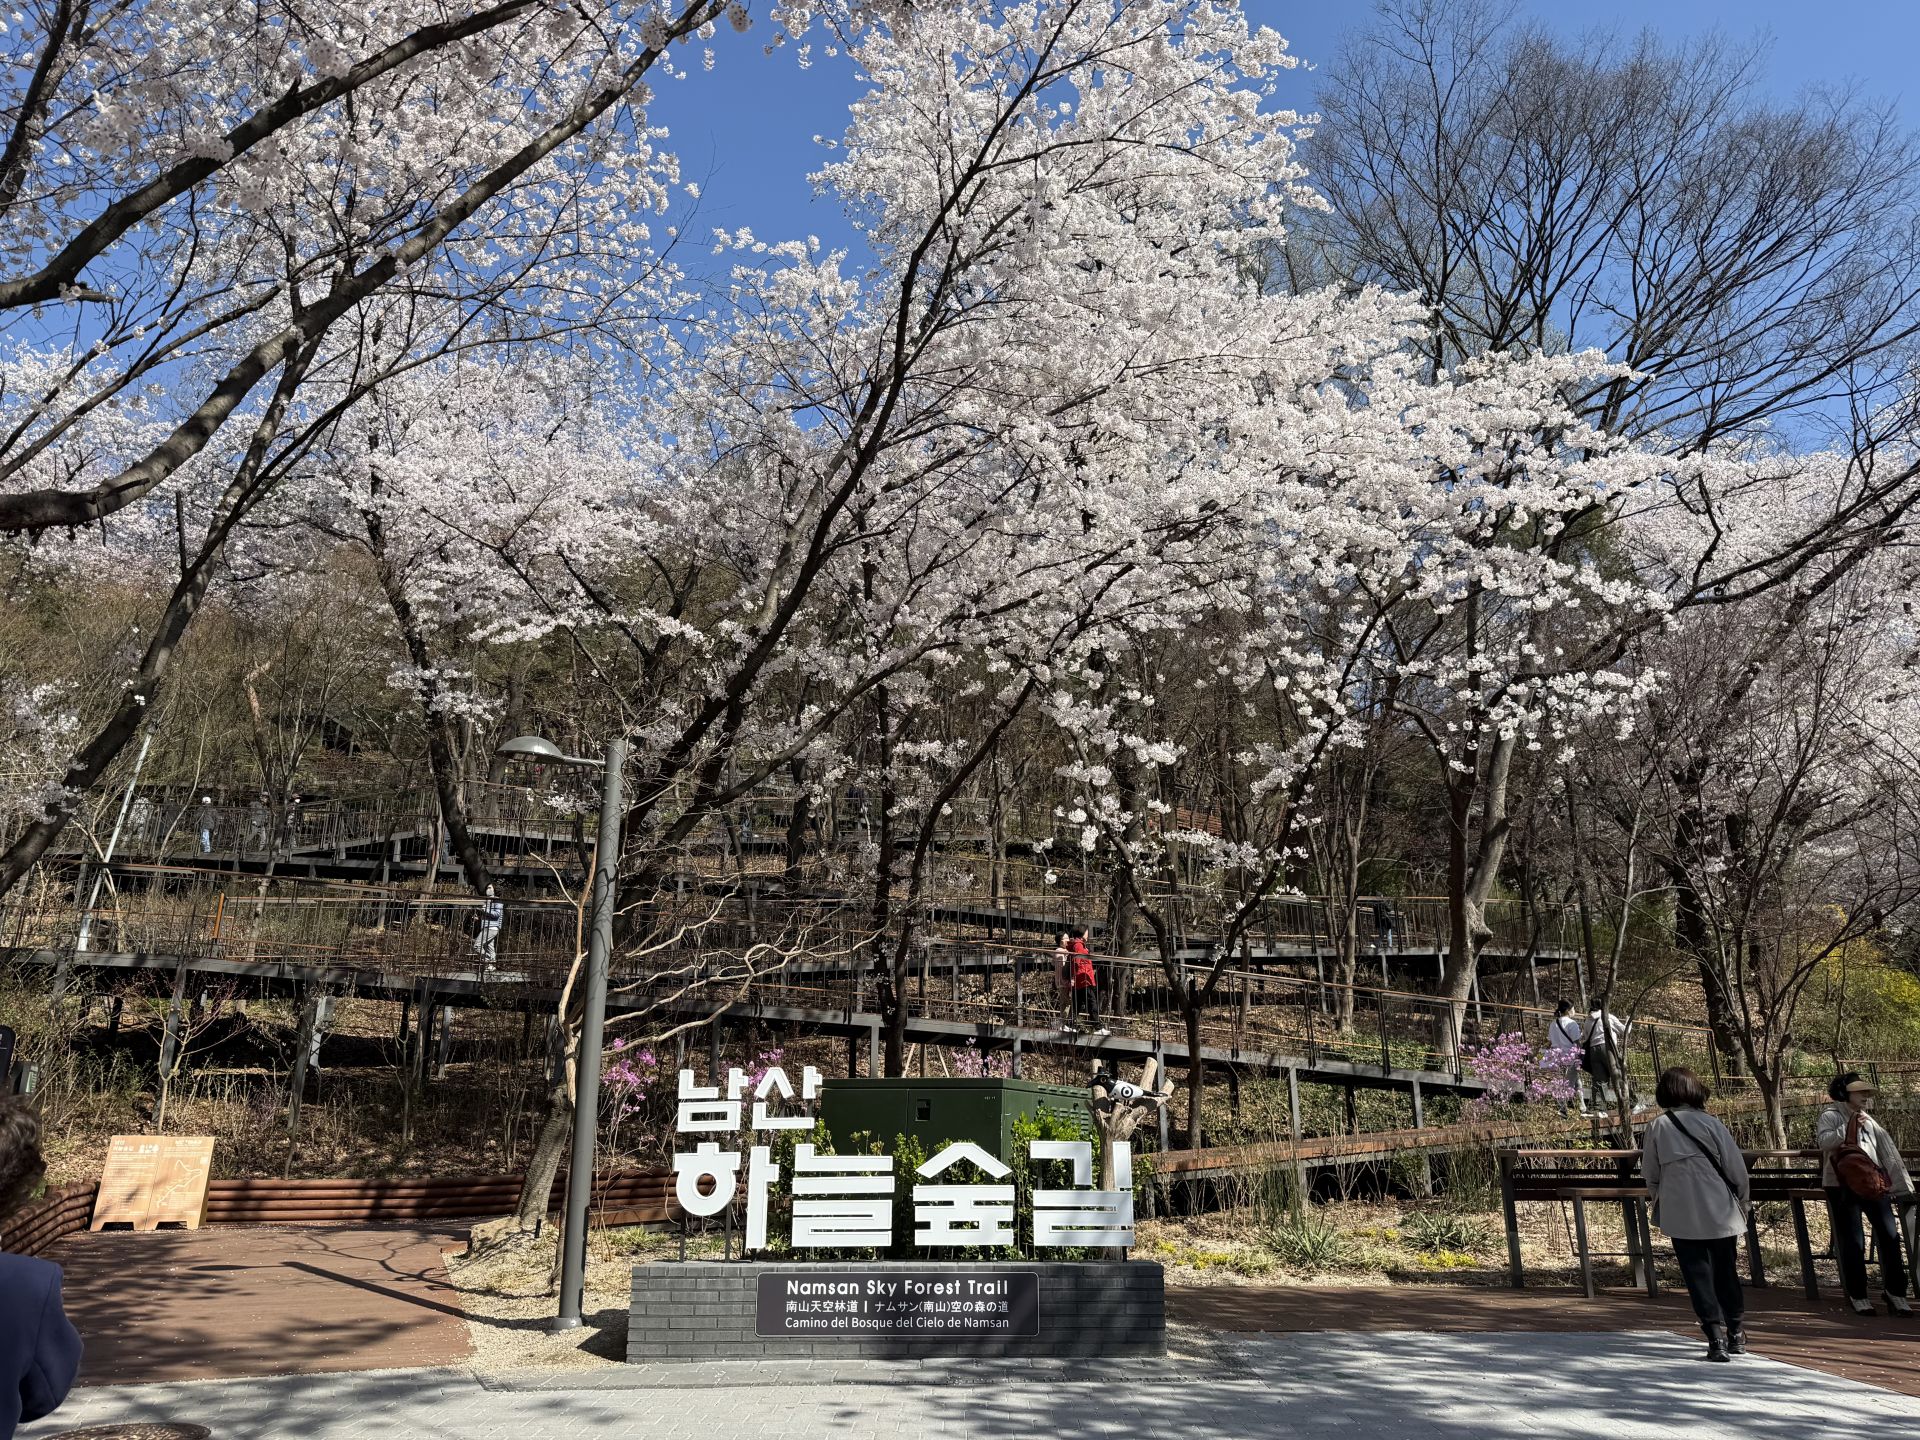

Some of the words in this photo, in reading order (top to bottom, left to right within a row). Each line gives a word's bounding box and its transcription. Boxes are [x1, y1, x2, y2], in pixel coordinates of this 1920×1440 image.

[677, 1065, 824, 1133] 남산
[673, 1141, 1135, 1249] 하늘숲길
[786, 1280, 860, 1296] Namsan
[866, 1279, 898, 1297] Sky
[904, 1279, 961, 1296] Forest
[967, 1279, 1008, 1296] Trail
[785, 1299, 859, 1313] 南山天空林道
[874, 1300, 1009, 1313] ナムサン(南山)空の森の道
[785, 1316, 829, 1329] Camino
[830, 1316, 849, 1328] del
[851, 1316, 893, 1331] Bosque
[895, 1316, 914, 1328] del
[915, 1316, 945, 1328] Cielo
[947, 1316, 962, 1328] de
[964, 1316, 1009, 1328] Namsan
